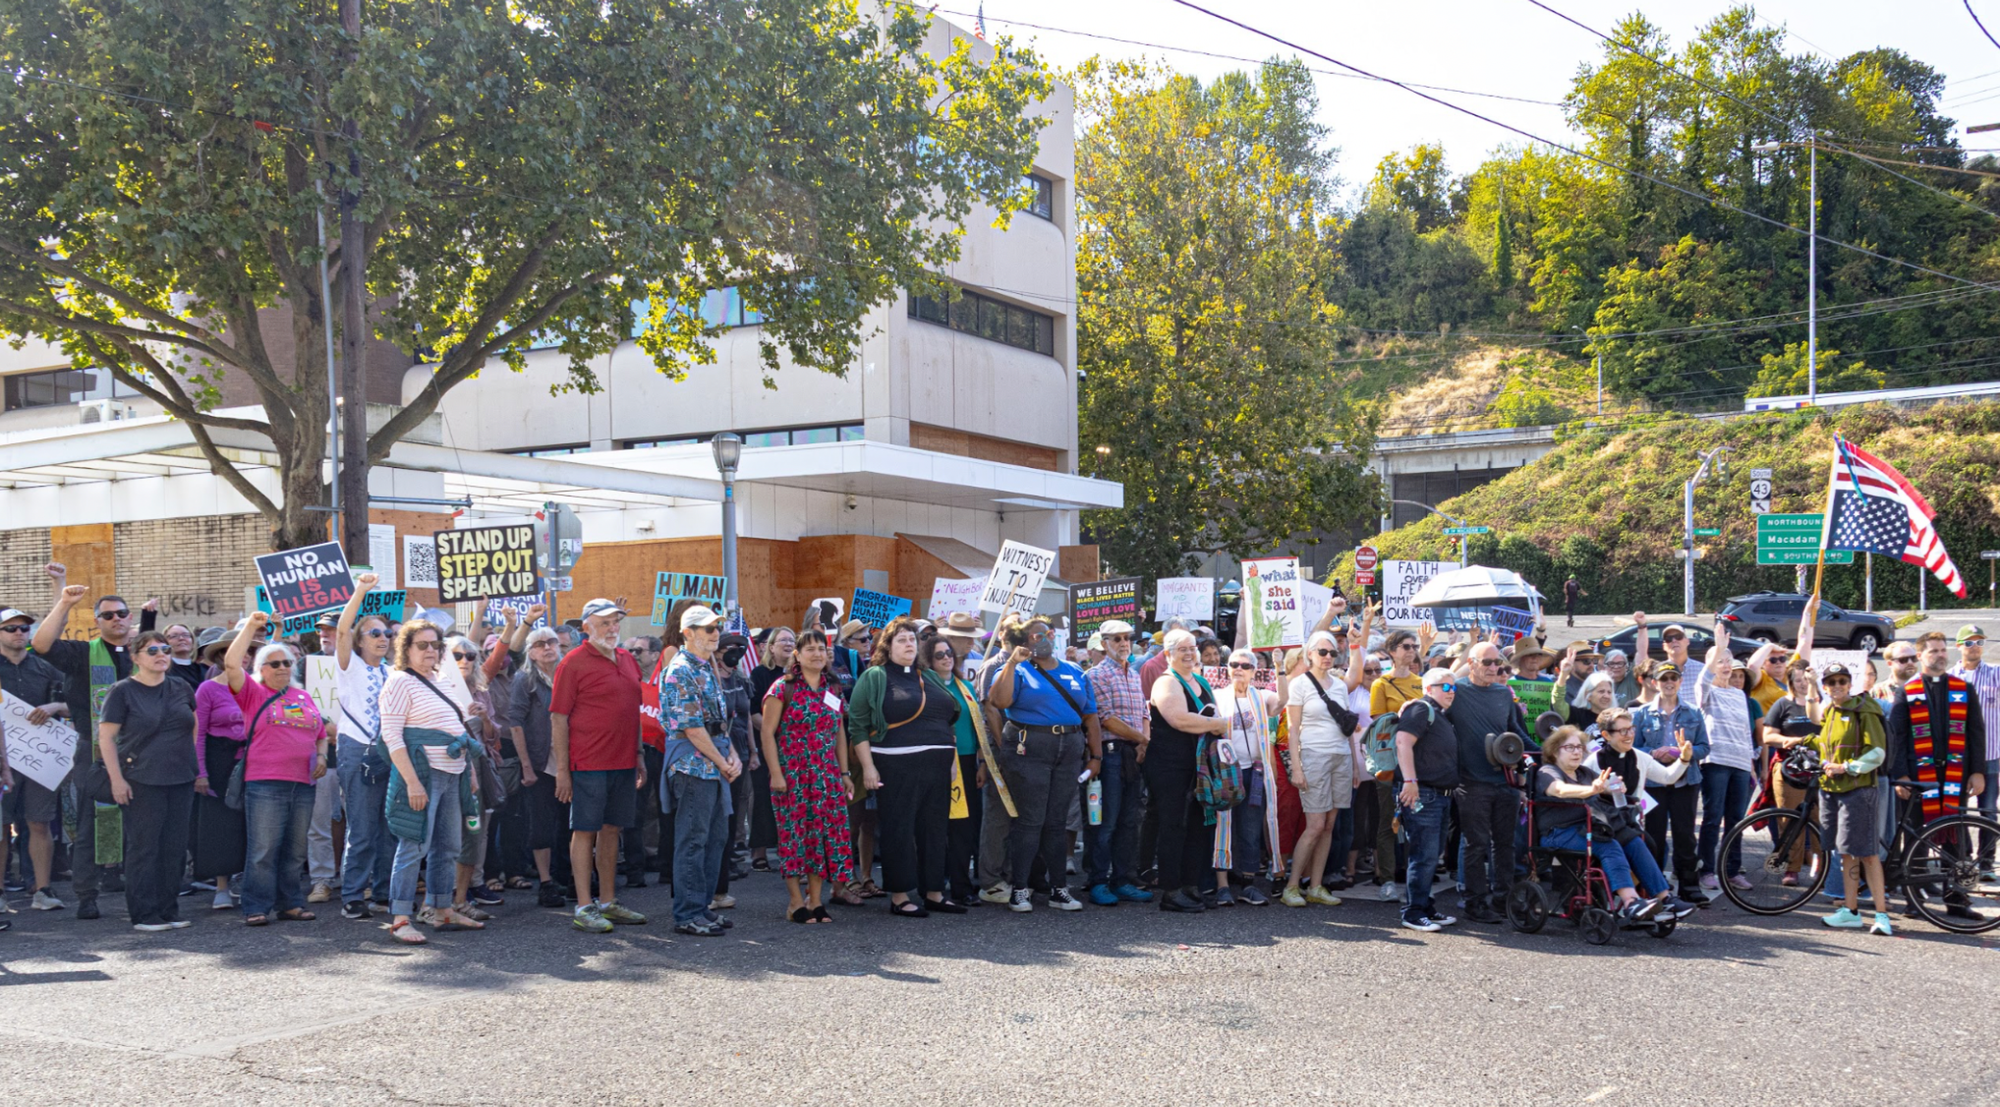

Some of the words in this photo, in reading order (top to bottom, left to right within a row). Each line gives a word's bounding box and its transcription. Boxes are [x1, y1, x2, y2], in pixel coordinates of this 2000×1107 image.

[1753, 483, 1768, 495] 43
[437, 529, 505, 555] STAND
[506, 526, 533, 549] UP
[1767, 535, 1818, 544] Macadam
[284, 551, 319, 570] NO
[1002, 546, 1051, 574] WITNESS
[1783, 552, 1844, 560] SOUTHBUND
[440, 553, 490, 579] STEP
[492, 549, 534, 574] OUT
[1398, 561, 1439, 576] FAITH
[266, 559, 345, 588] HUMAN
[1008, 569, 1028, 589] TO
[1261, 569, 1297, 583] what
[298, 578, 322, 595] IS
[442, 574, 506, 600] SPEAK
[507, 571, 535, 593] UP
[658, 572, 725, 600] HUMAN
[1077, 588, 1092, 597] WE
[1096, 583, 1135, 595] BELIEVE
[1268, 585, 1292, 597] she
[1399, 582, 1423, 596] FEA
[276, 585, 353, 615] ILLEGAL
[383, 592, 405, 606] OFF
[854, 597, 889, 612] RIGHTS
[855, 588, 900, 606] MIGRANT
[984, 587, 1037, 613] INJUSTICE
[1096, 594, 1112, 602] LIVES
[1265, 598, 1296, 611] said
[851, 605, 890, 621] HUMAN
[1076, 608, 1099, 618] LOVE
[1102, 606, 1111, 615] IS
[1113, 603, 1135, 613] LOVE
[1161, 602, 1193, 616] ALLIES
[1386, 607, 1410, 620] OUR
[1460, 611, 1493, 621] NEXT?
[1077, 622, 1102, 632] SCIENC
[1522, 683, 1533, 692] ICE
